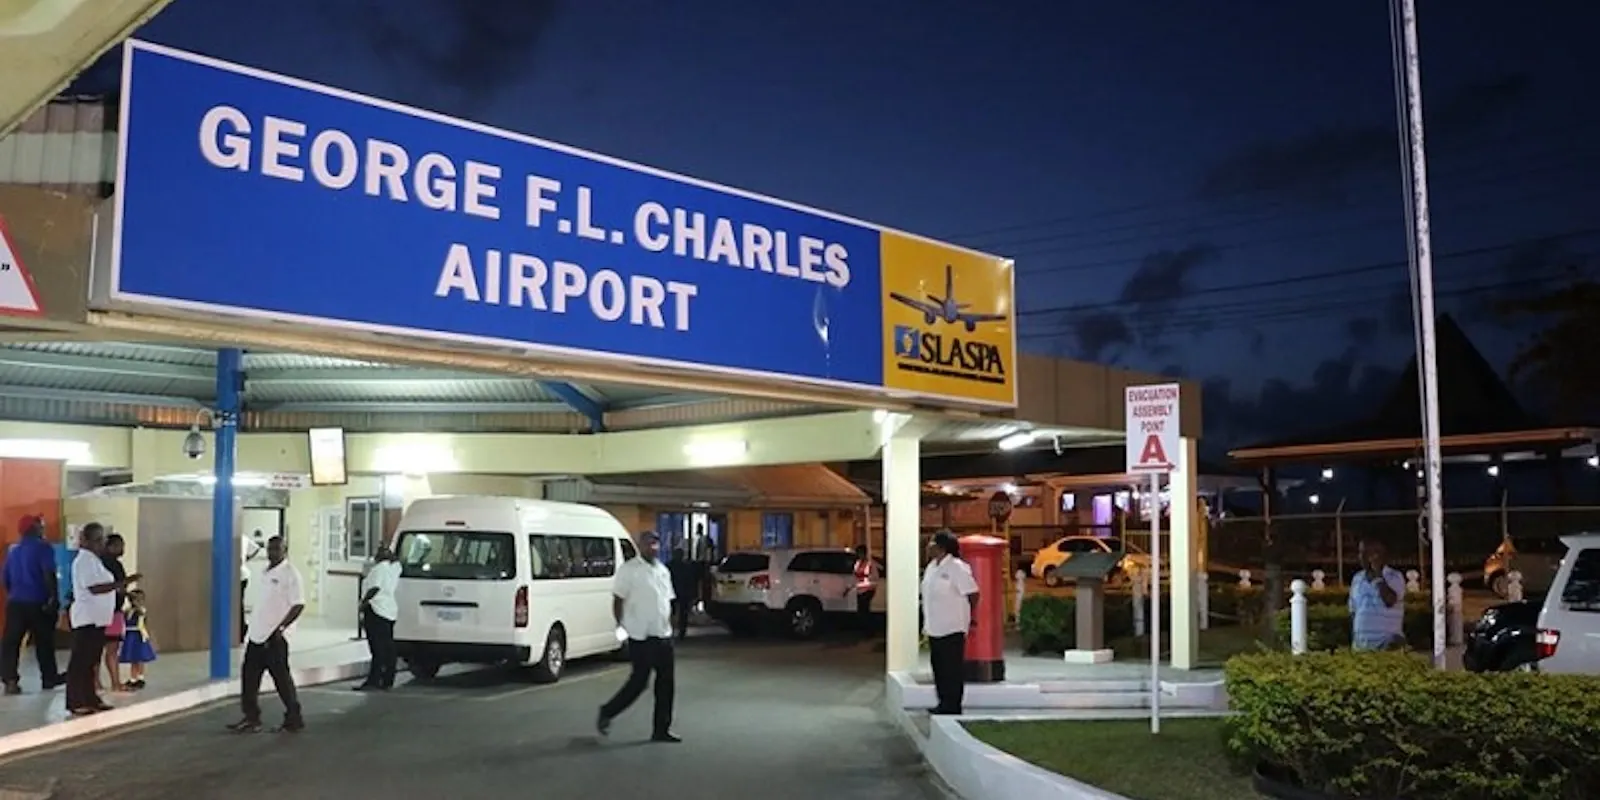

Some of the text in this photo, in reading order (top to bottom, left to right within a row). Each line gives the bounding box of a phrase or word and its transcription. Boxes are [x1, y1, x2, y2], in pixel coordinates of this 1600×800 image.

[200, 106, 850, 288] GEORGE F.L. CHARLES
[435, 243, 697, 332] AIRPORT
[919, 332, 1004, 375] SLASPA
[1128, 387, 1177, 402] EVACUATION
[1132, 404, 1173, 417] ASSEMBLY
[1141, 420, 1165, 432] POINT
[1140, 434, 1167, 463] A
